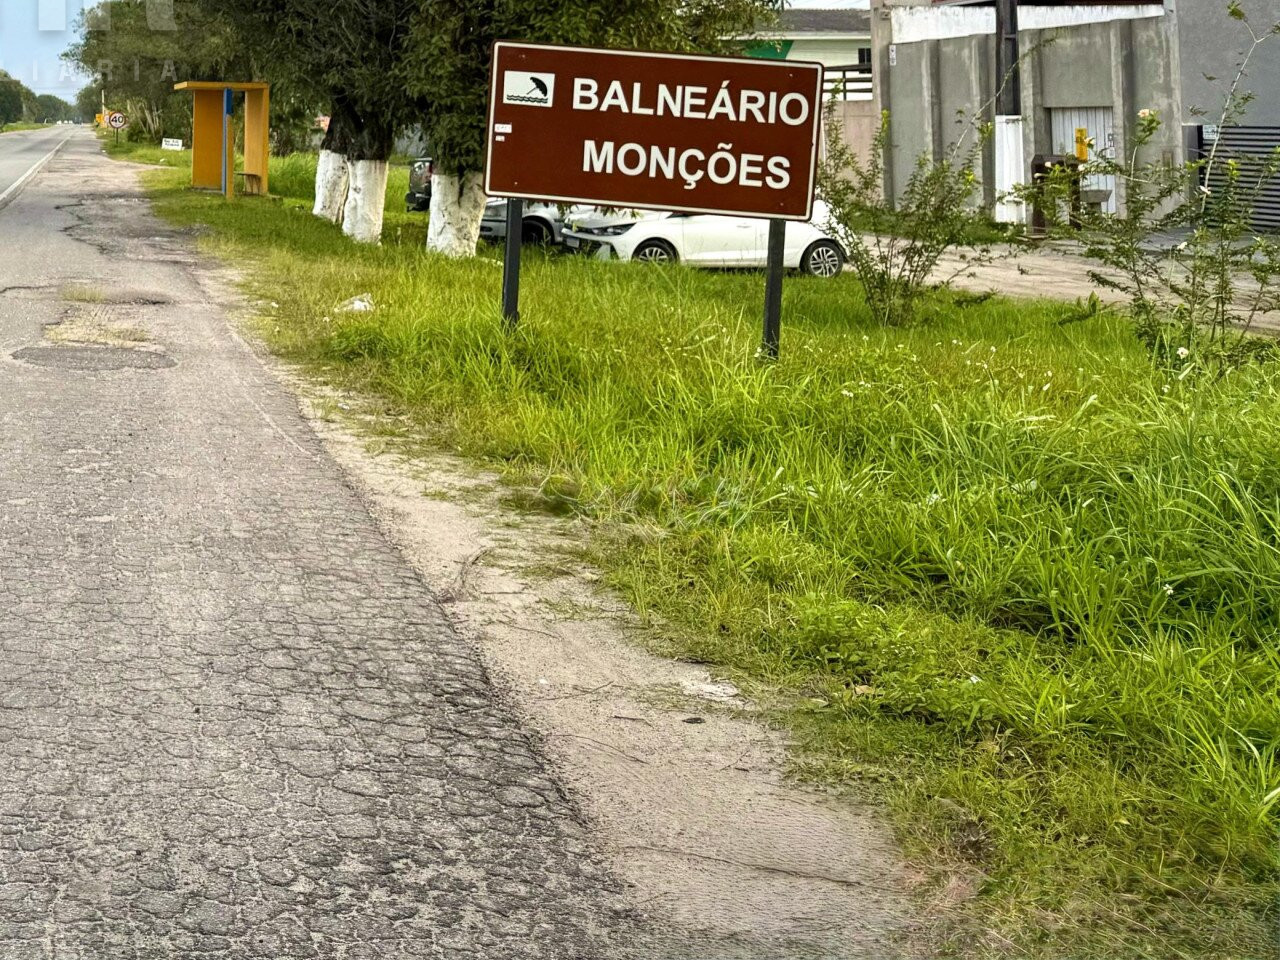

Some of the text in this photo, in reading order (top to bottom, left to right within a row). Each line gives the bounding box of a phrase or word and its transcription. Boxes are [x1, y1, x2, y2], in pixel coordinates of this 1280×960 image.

[111, 116, 124, 124] 40
[572, 77, 809, 126] BALNEÁRIO
[582, 140, 790, 190] MONÇÕES
